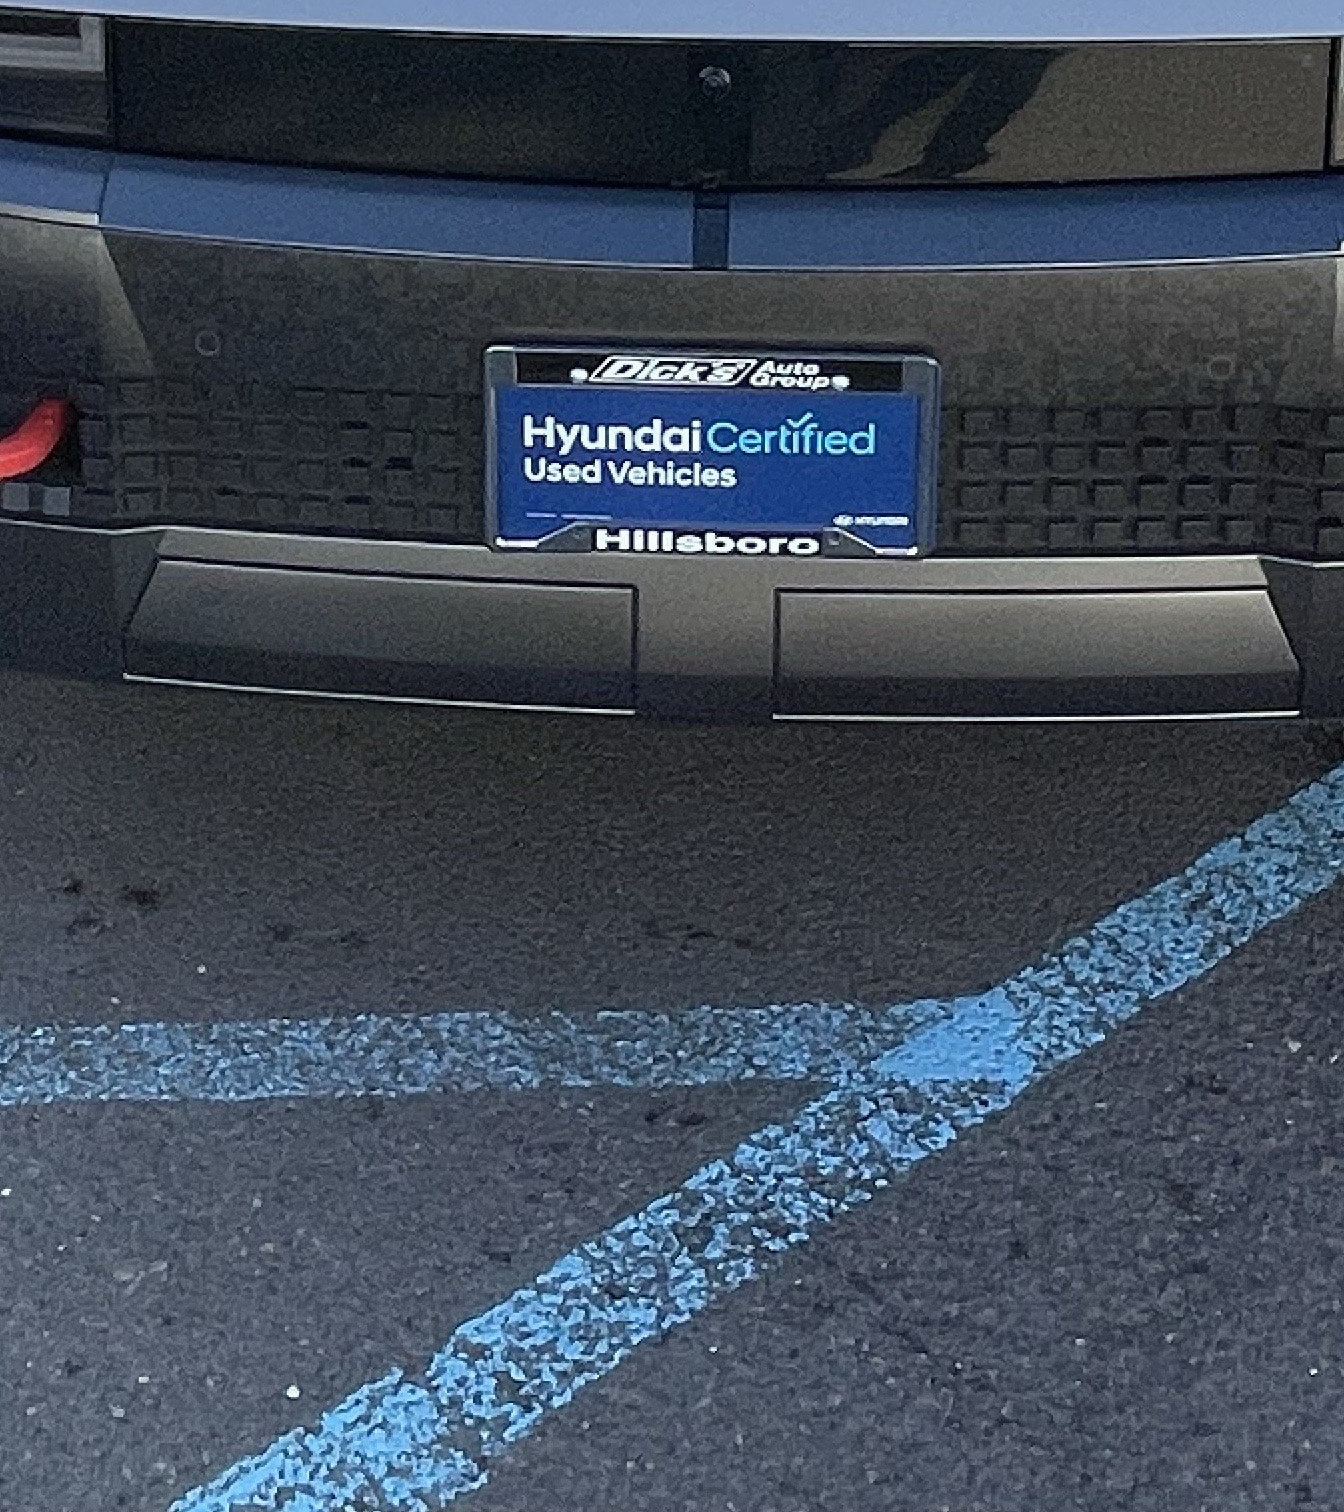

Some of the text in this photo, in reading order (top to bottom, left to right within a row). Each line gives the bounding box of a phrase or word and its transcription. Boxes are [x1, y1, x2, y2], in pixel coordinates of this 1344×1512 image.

[756, 359, 820, 376] Auto
[750, 374, 830, 390] Group
[522, 412, 876, 455] Hyundai Certified
[523, 457, 738, 487] Used Vehicles
[595, 528, 820, 555] Hillsboro
